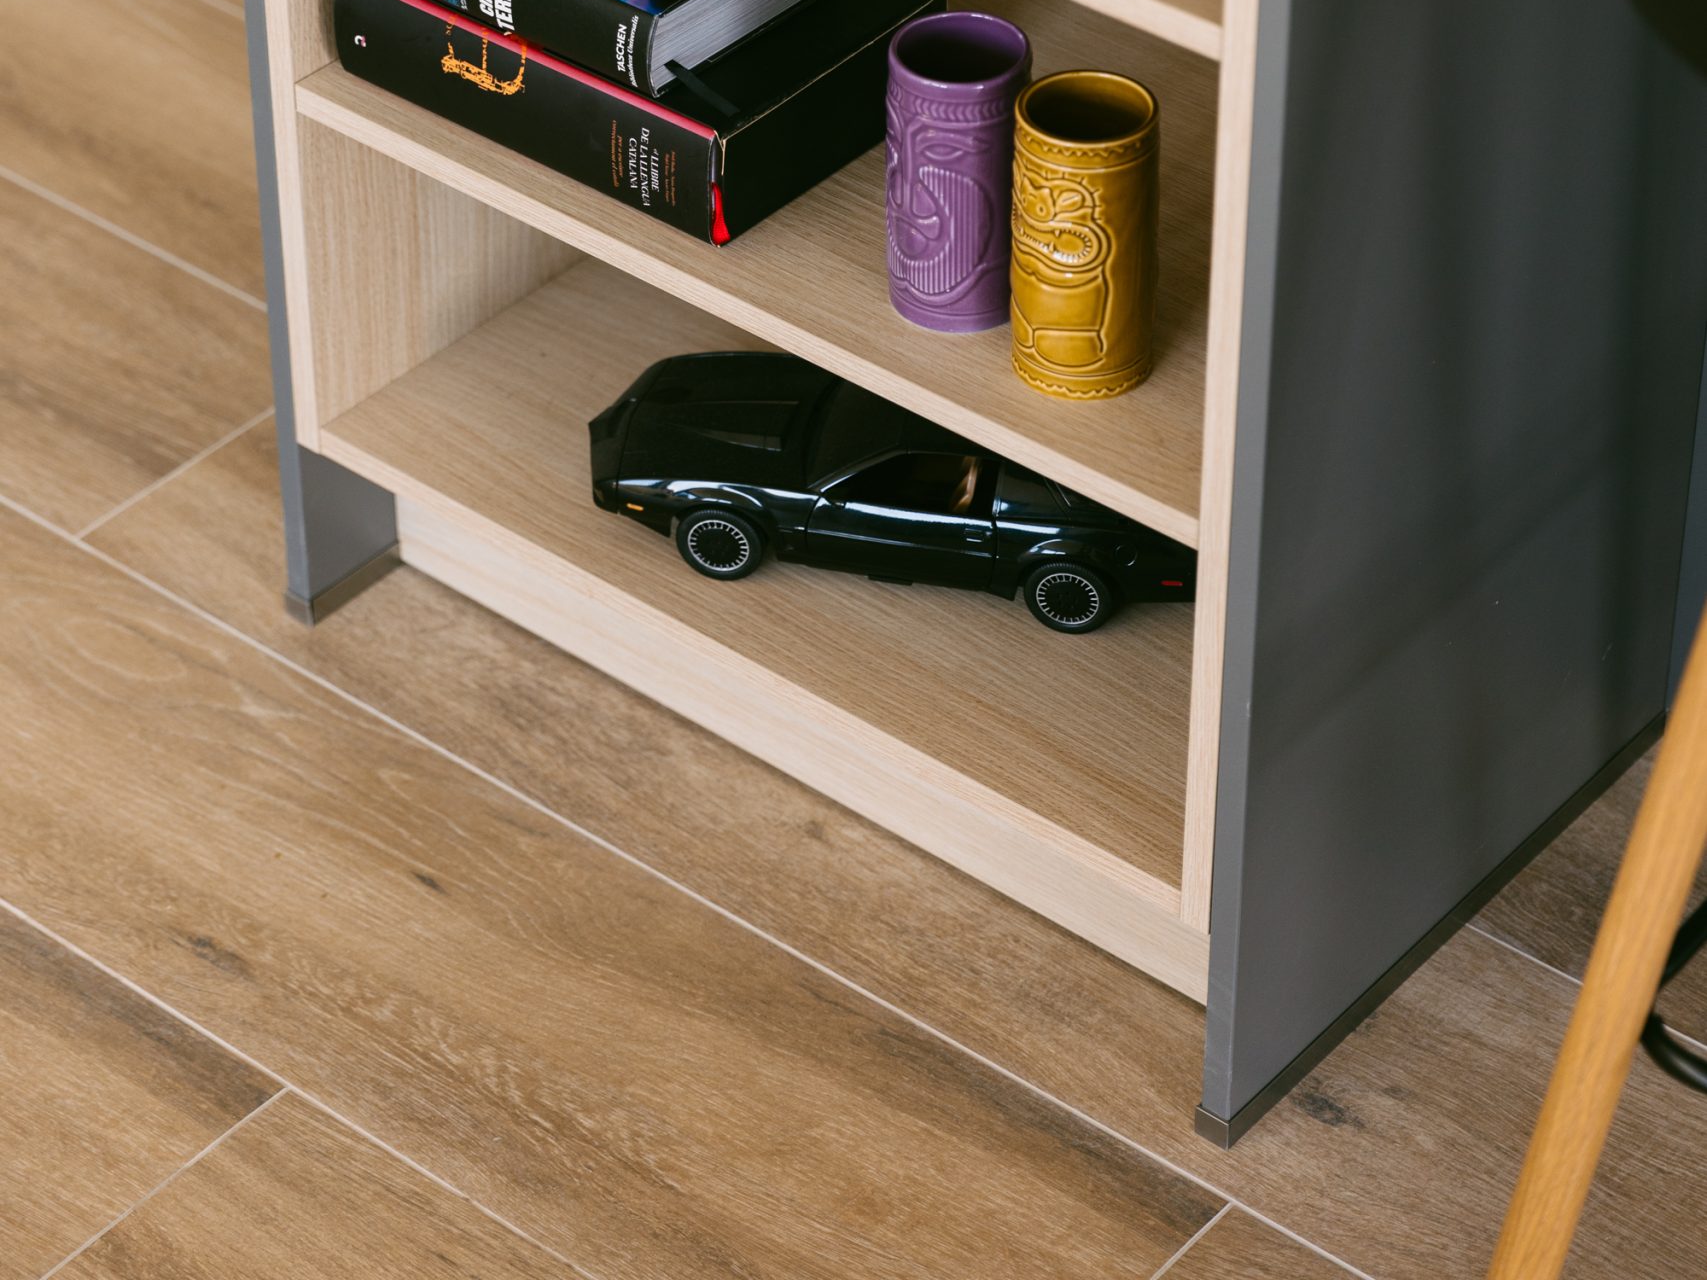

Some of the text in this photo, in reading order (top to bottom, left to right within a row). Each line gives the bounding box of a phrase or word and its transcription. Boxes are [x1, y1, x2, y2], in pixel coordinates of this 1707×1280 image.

[616, 23, 628, 72] TASCHEN
[627, 14, 640, 54] Universalis
[628, 137, 639, 189] CATALANA
[640, 127, 651, 207] DE LA LLENGUA
[650, 155, 660, 193] LLIBRE
